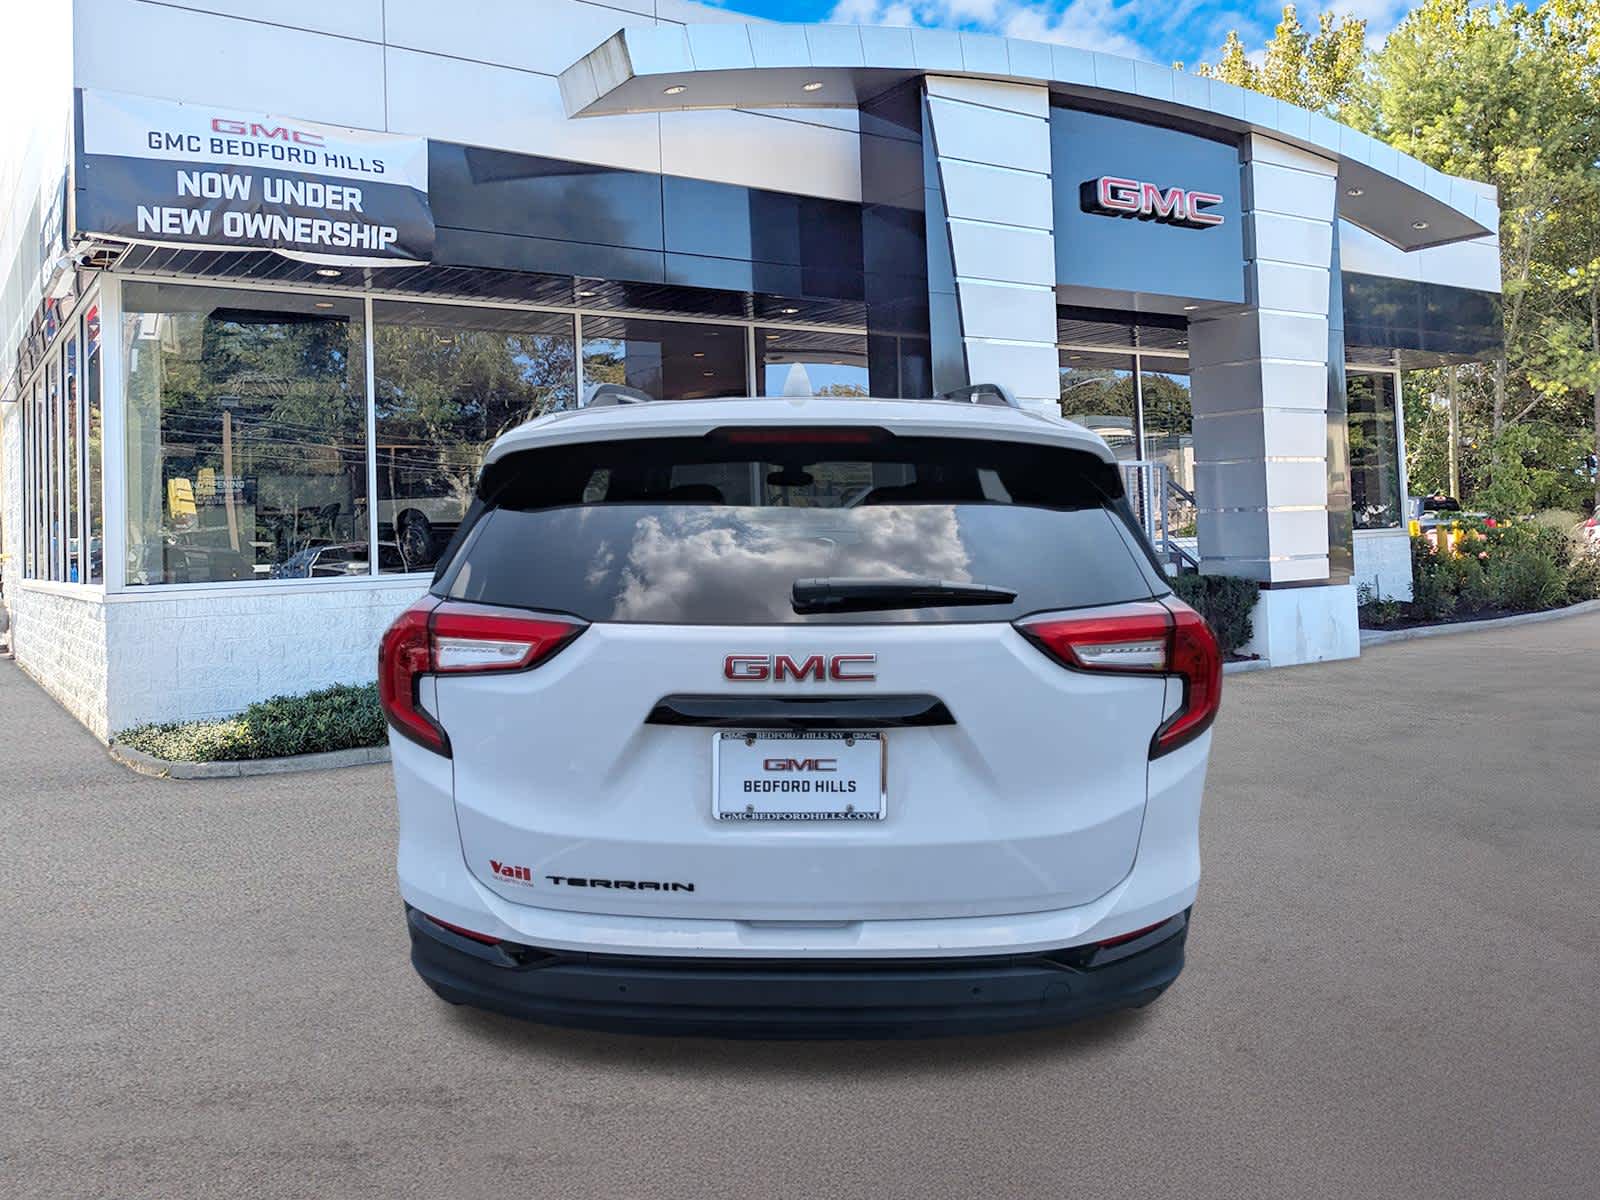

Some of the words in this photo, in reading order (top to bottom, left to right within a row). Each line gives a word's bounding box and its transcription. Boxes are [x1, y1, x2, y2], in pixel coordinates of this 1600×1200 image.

[211, 118, 326, 148] GMC
[147, 131, 202, 153] GMC
[209, 138, 317, 165] BEDFORD
[325, 154, 385, 174] HILLS
[176, 170, 252, 201] NOW
[263, 177, 363, 213] UNDER
[1097, 175, 1225, 225] GMC
[137, 205, 212, 236] NEW
[222, 211, 398, 251] OWNERSHIP
[724, 653, 877, 682] GMC
[803, 731, 828, 740] HILLS
[831, 731, 845, 740] NY
[763, 758, 837, 772] GMC
[743, 780, 811, 793] BEDFORD
[815, 780, 857, 793] HILLS
[722, 812, 879, 821] GMCBEDFORDHILLS.COM
[489, 859, 531, 881] Vail
[545, 875, 695, 892] TERRAIN
